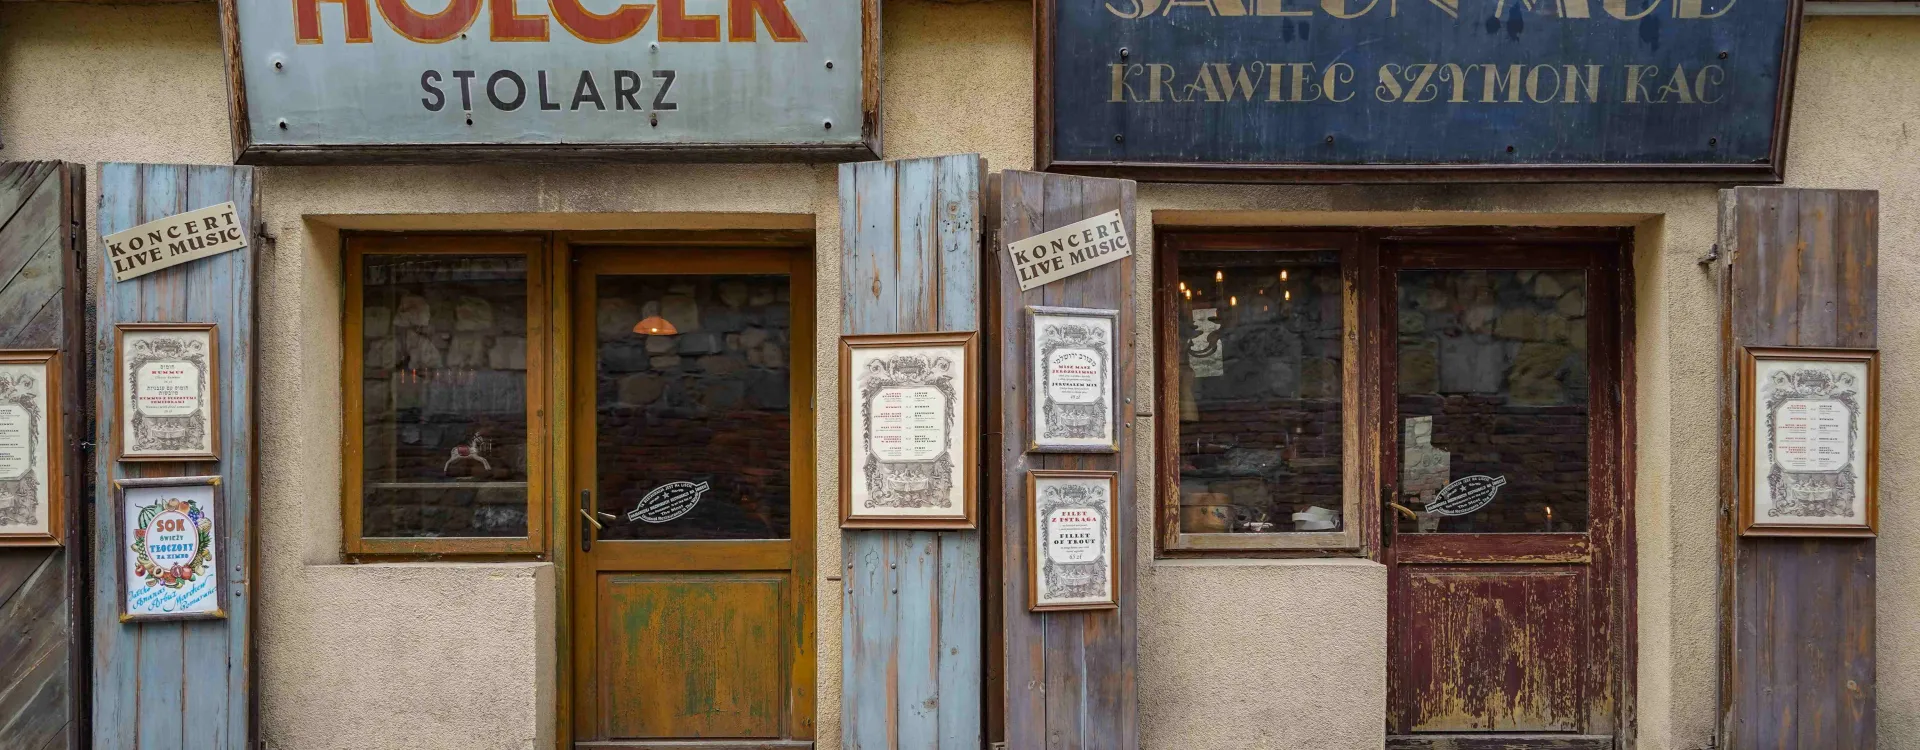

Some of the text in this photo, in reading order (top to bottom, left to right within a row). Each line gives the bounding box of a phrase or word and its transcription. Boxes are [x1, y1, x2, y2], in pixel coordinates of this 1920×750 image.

[420, 69, 680, 112] STOLARZ
[1106, 61, 1725, 104] KRAWIEC SZYMON KAC
[109, 211, 234, 258] KONCERT
[113, 227, 241, 273] LIVE MUSIC
[1014, 220, 1120, 266] KONCERT
[1018, 235, 1127, 282] LIVE MUSIC
[156, 519, 185, 532] SOK
